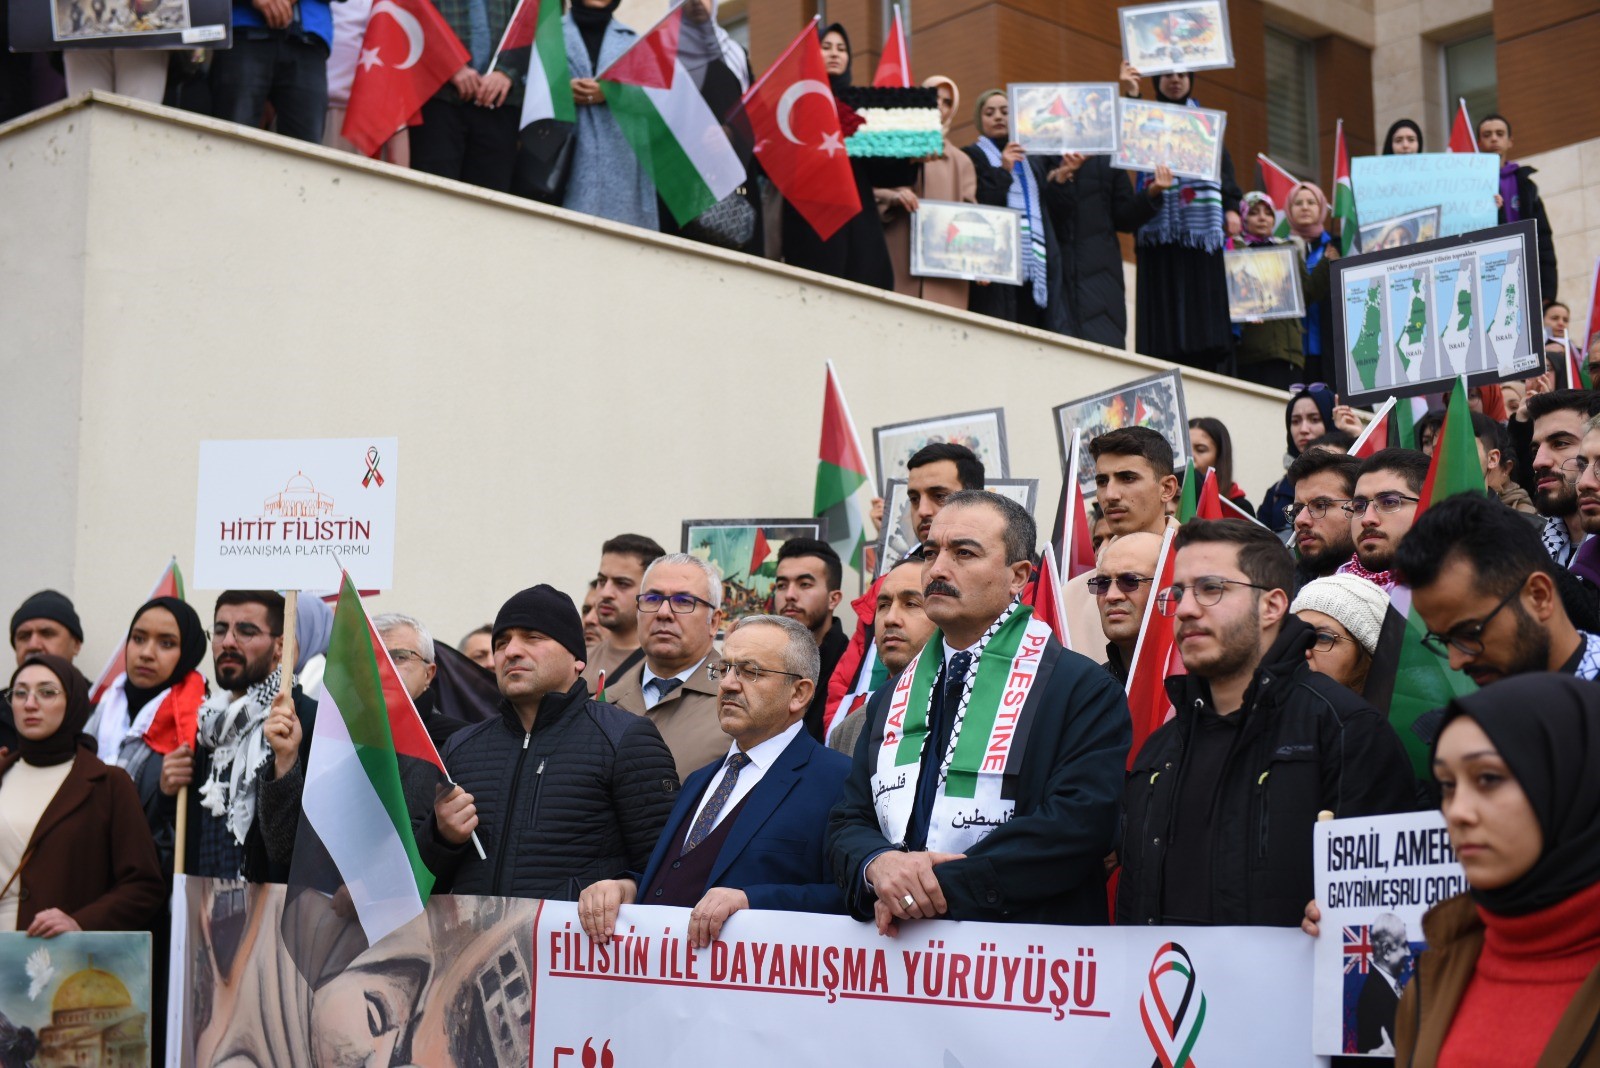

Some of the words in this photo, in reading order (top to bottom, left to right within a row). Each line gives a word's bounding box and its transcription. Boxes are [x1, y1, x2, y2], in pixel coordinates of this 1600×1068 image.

[220, 517, 276, 541] HİTİT
[283, 516, 371, 541] FİLİSTİN
[220, 545, 291, 557] DAYANIŞMA
[295, 544, 370, 556] PLATFORMU
[982, 633, 1046, 771] PALESTINE
[1327, 827, 1389, 874] İSRAİL,
[1328, 875, 1422, 911] GAYRİMEŞRU
[550, 921, 650, 976] FİLİSTİN
[659, 927, 698, 980] İLE
[710, 940, 889, 1004] DAYANIŞMA
[902, 939, 1097, 1021] YÜRÜYÜŞÜ
